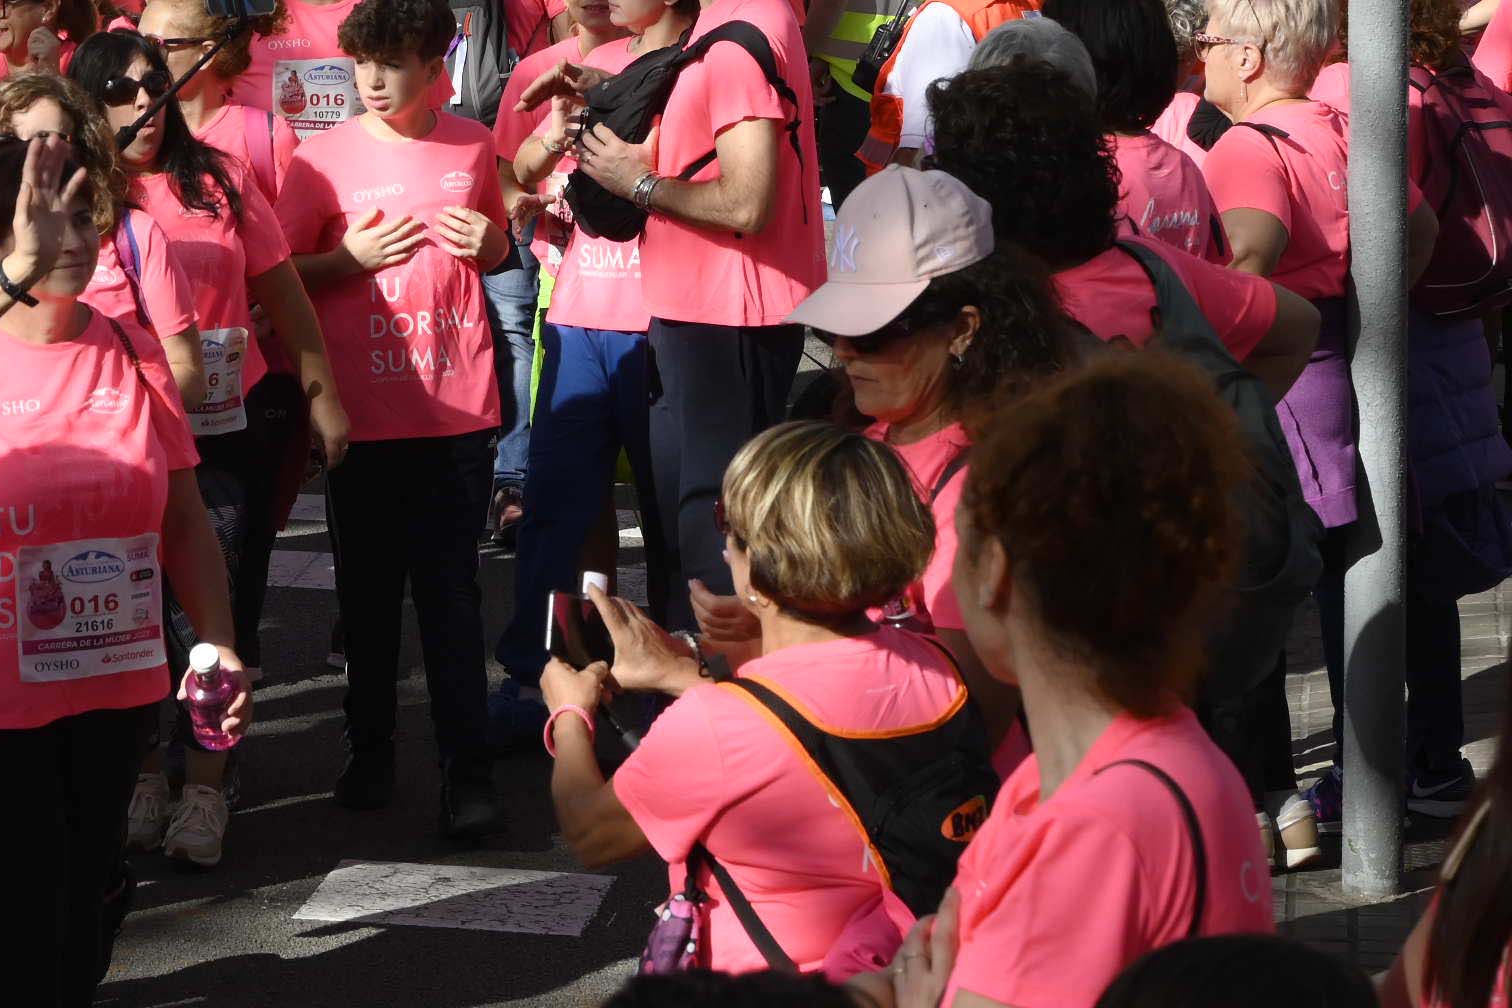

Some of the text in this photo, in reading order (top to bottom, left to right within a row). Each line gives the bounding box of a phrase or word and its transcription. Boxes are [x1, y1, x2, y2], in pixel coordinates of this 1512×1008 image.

[268, 38, 311, 50] OYSHO
[308, 72, 347, 81] ASTURIANA
[309, 93, 345, 107] 016
[313, 111, 341, 119] 10779
[579, 243, 641, 270] SUMA
[367, 276, 401, 303] TU
[369, 305, 474, 339] DORSAL
[371, 346, 453, 375] SUMA
[65, 562, 121, 578] ASTURIANA
[70, 593, 120, 615] 016
[75, 618, 114, 633] 21616
[111, 650, 155, 665] Santander
[34, 658, 80, 673] OYSHO
